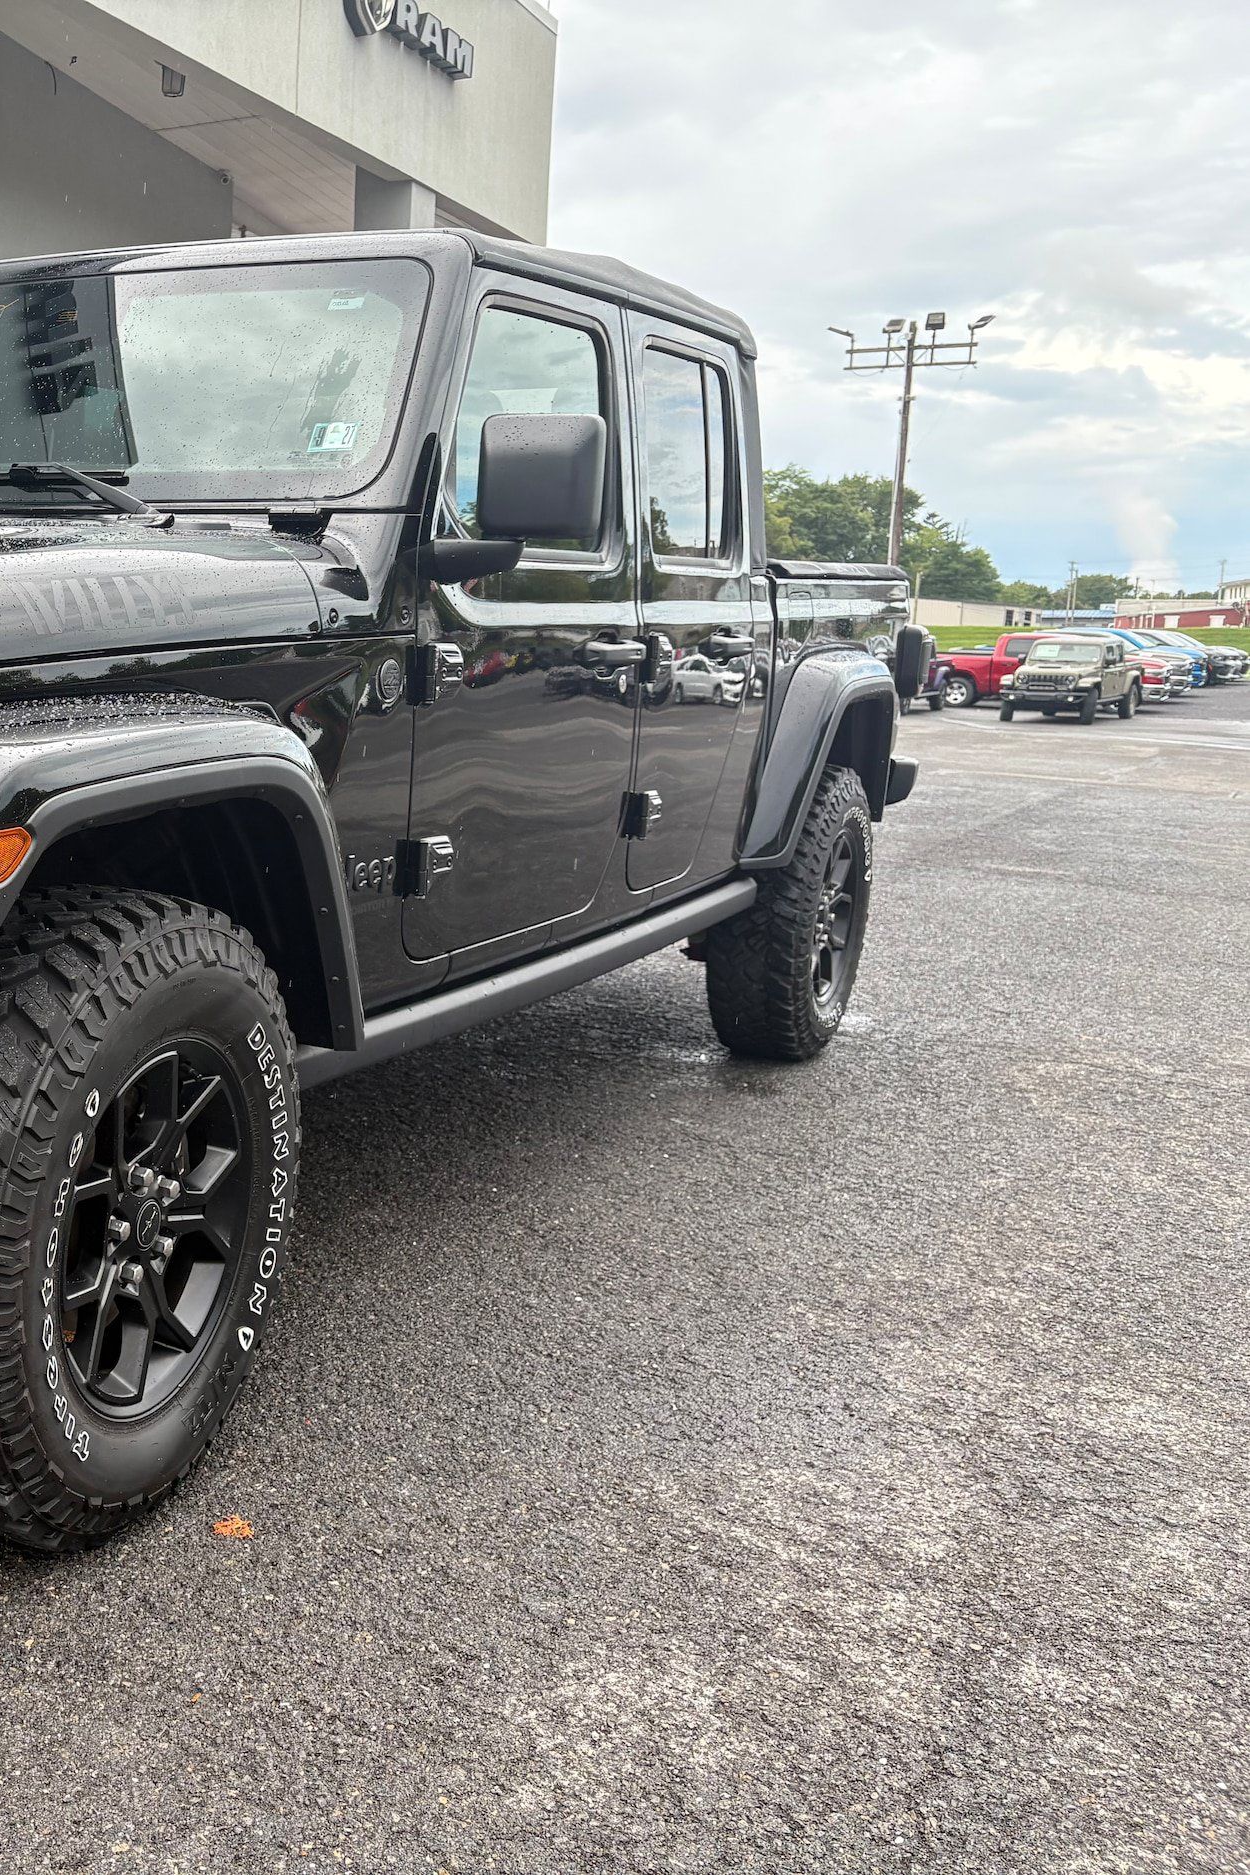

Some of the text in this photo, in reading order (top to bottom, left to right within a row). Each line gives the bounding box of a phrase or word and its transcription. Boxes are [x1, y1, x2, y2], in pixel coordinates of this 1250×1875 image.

[393, 0, 474, 79] RAM
[347, 854, 397, 896] Jeep
[247, 1021, 291, 1317] DESTINATION
